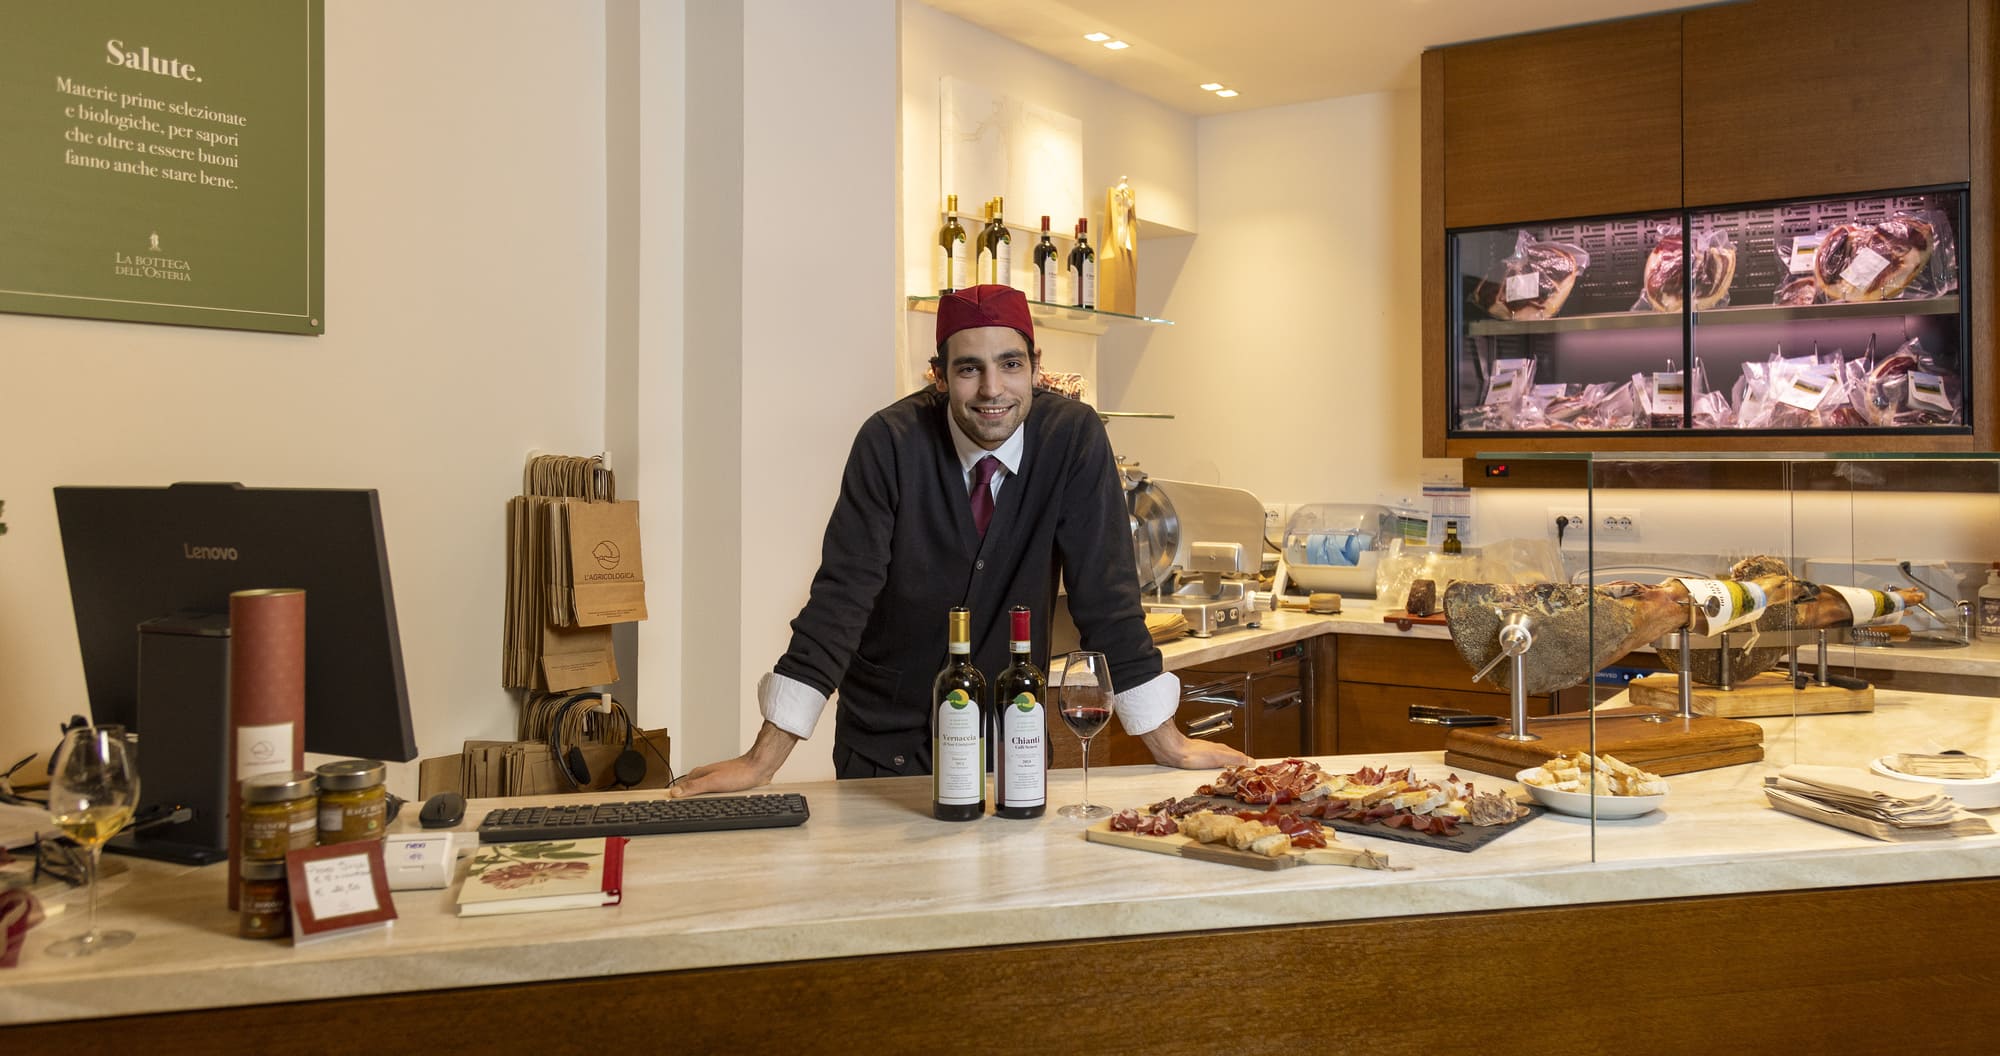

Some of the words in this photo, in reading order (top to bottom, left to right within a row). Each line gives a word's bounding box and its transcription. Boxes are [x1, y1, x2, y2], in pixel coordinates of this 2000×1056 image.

[106, 39, 203, 83] Salute.
[56, 76, 118, 103] Materie
[121, 92, 166, 112] prime
[168, 101, 247, 127] selezionate
[64, 106, 75, 118] e
[78, 103, 165, 135] biologiche,
[168, 124, 193, 141] per
[195, 130, 239, 148] sapori
[64, 127, 94, 144] che
[97, 131, 134, 151] oltre
[137, 142, 146, 153] a
[148, 144, 195, 161] essere
[198, 148, 239, 168] buoni
[65, 148, 110, 170] fanno
[113, 160, 158, 178] anche
[161, 168, 197, 184] stare
[200, 170, 238, 190] bene.
[183, 543, 238, 560] Lenovo
[584, 572, 635, 581] L'AGRICOLOGICA
[1011, 736, 1040, 745] Chianti
